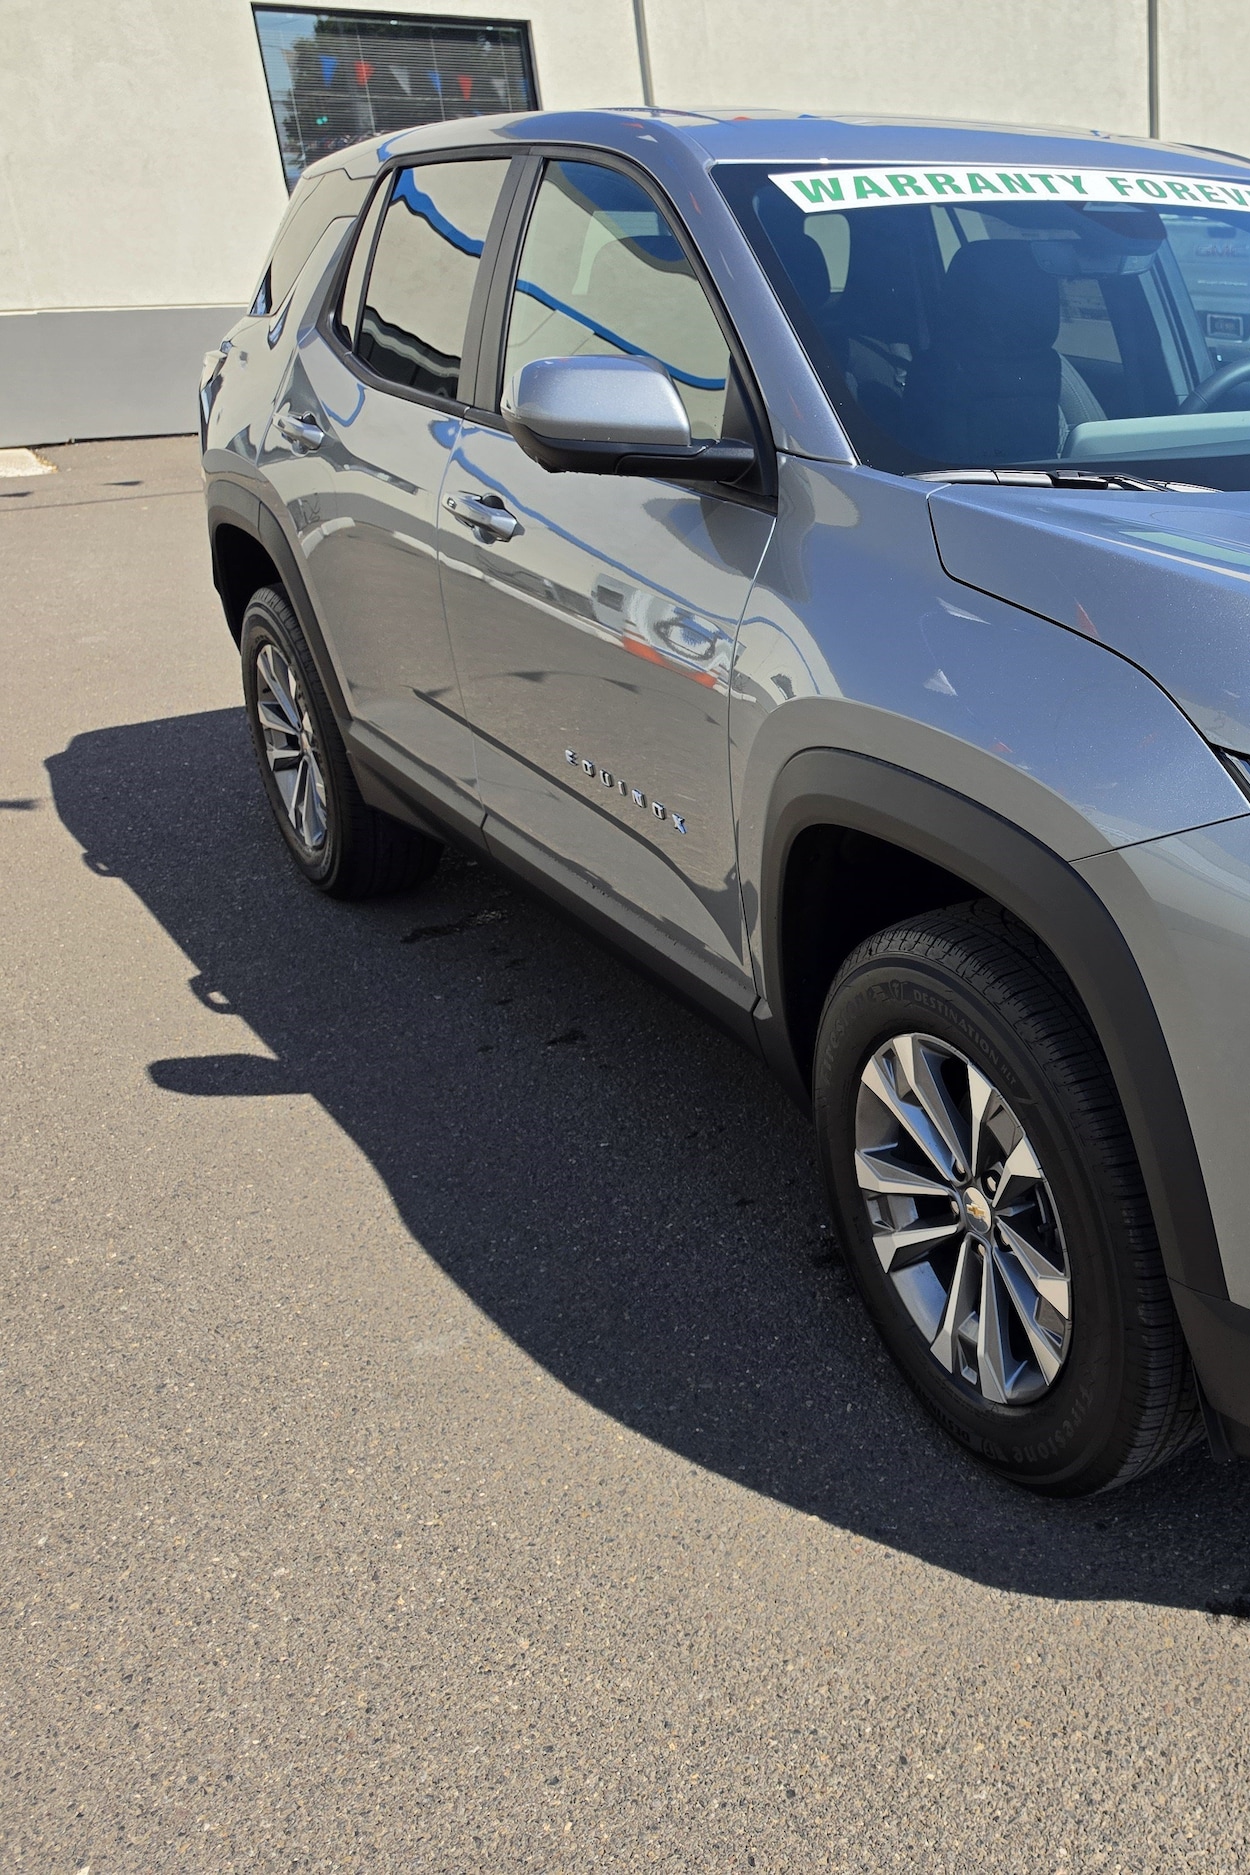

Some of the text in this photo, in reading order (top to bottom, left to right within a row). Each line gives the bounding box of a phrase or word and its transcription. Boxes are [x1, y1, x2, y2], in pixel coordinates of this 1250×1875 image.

[791, 172, 1088, 203] WARRANTY
[564, 748, 688, 835] EQUINOX
[912, 988, 1000, 1066] DESTINATION
